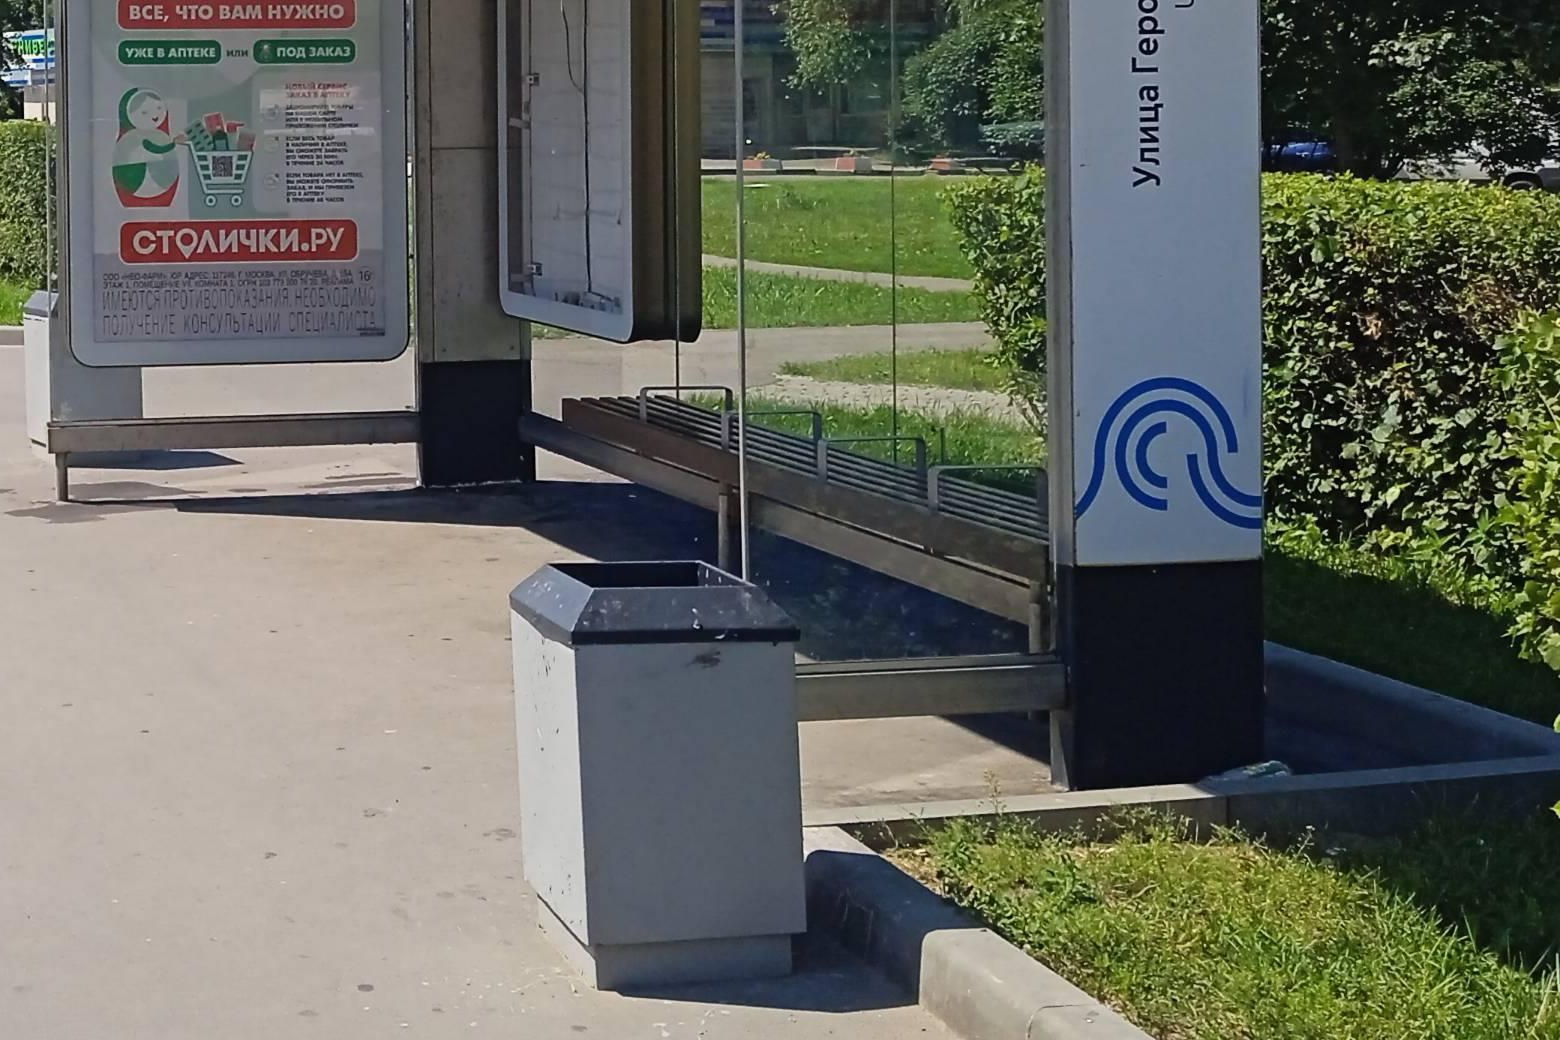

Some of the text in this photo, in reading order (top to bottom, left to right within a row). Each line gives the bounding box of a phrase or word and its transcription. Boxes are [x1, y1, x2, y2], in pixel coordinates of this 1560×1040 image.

[128, 4, 345, 22] ВСЕ, ЧТО ВАМ НУЖНО
[125, 47, 155, 59] УЖЕ
[157, 48, 165, 58] В
[168, 47, 216, 59] АПТЕКЕ
[276, 47, 306, 60] ПОД
[309, 46, 351, 58] ЗАКАЗ
[1132, 85, 1163, 187] Улица
[132, 227, 345, 259] СТОЛИЧКИ.РУ
[102, 289, 161, 312] ИМЕЮТСЯ
[295, 285, 377, 309] НЕОБХОДИМО
[102, 310, 376, 336] ПОЛУЧЕНИЕ КОНСУЛЬТАЦИИ СПЕЦИАЛИСТА
